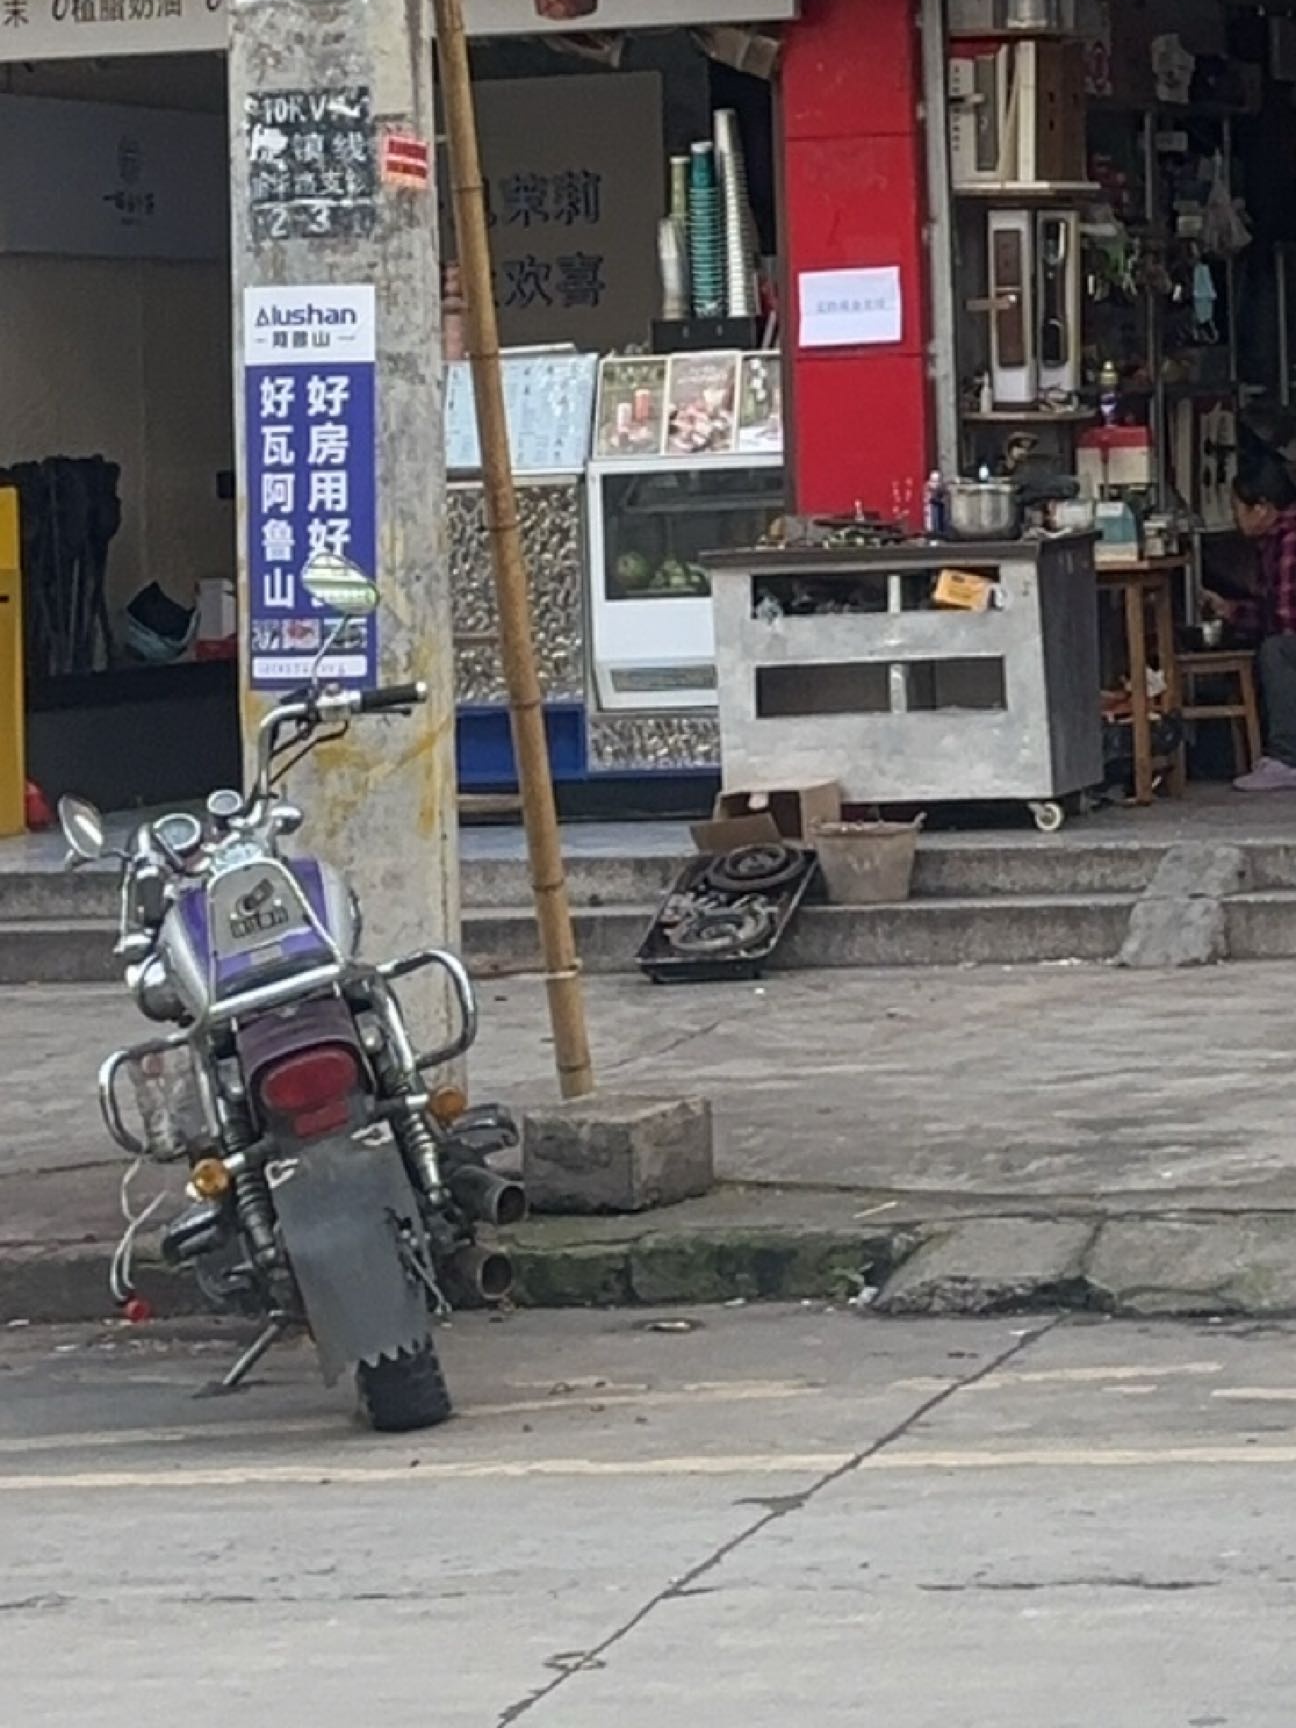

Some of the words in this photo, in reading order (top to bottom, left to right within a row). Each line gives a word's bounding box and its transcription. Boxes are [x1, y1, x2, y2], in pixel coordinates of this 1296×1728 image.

[259, 375, 296, 609] 好瓦阿鲁山
[307, 375, 350, 608] 好房用好
